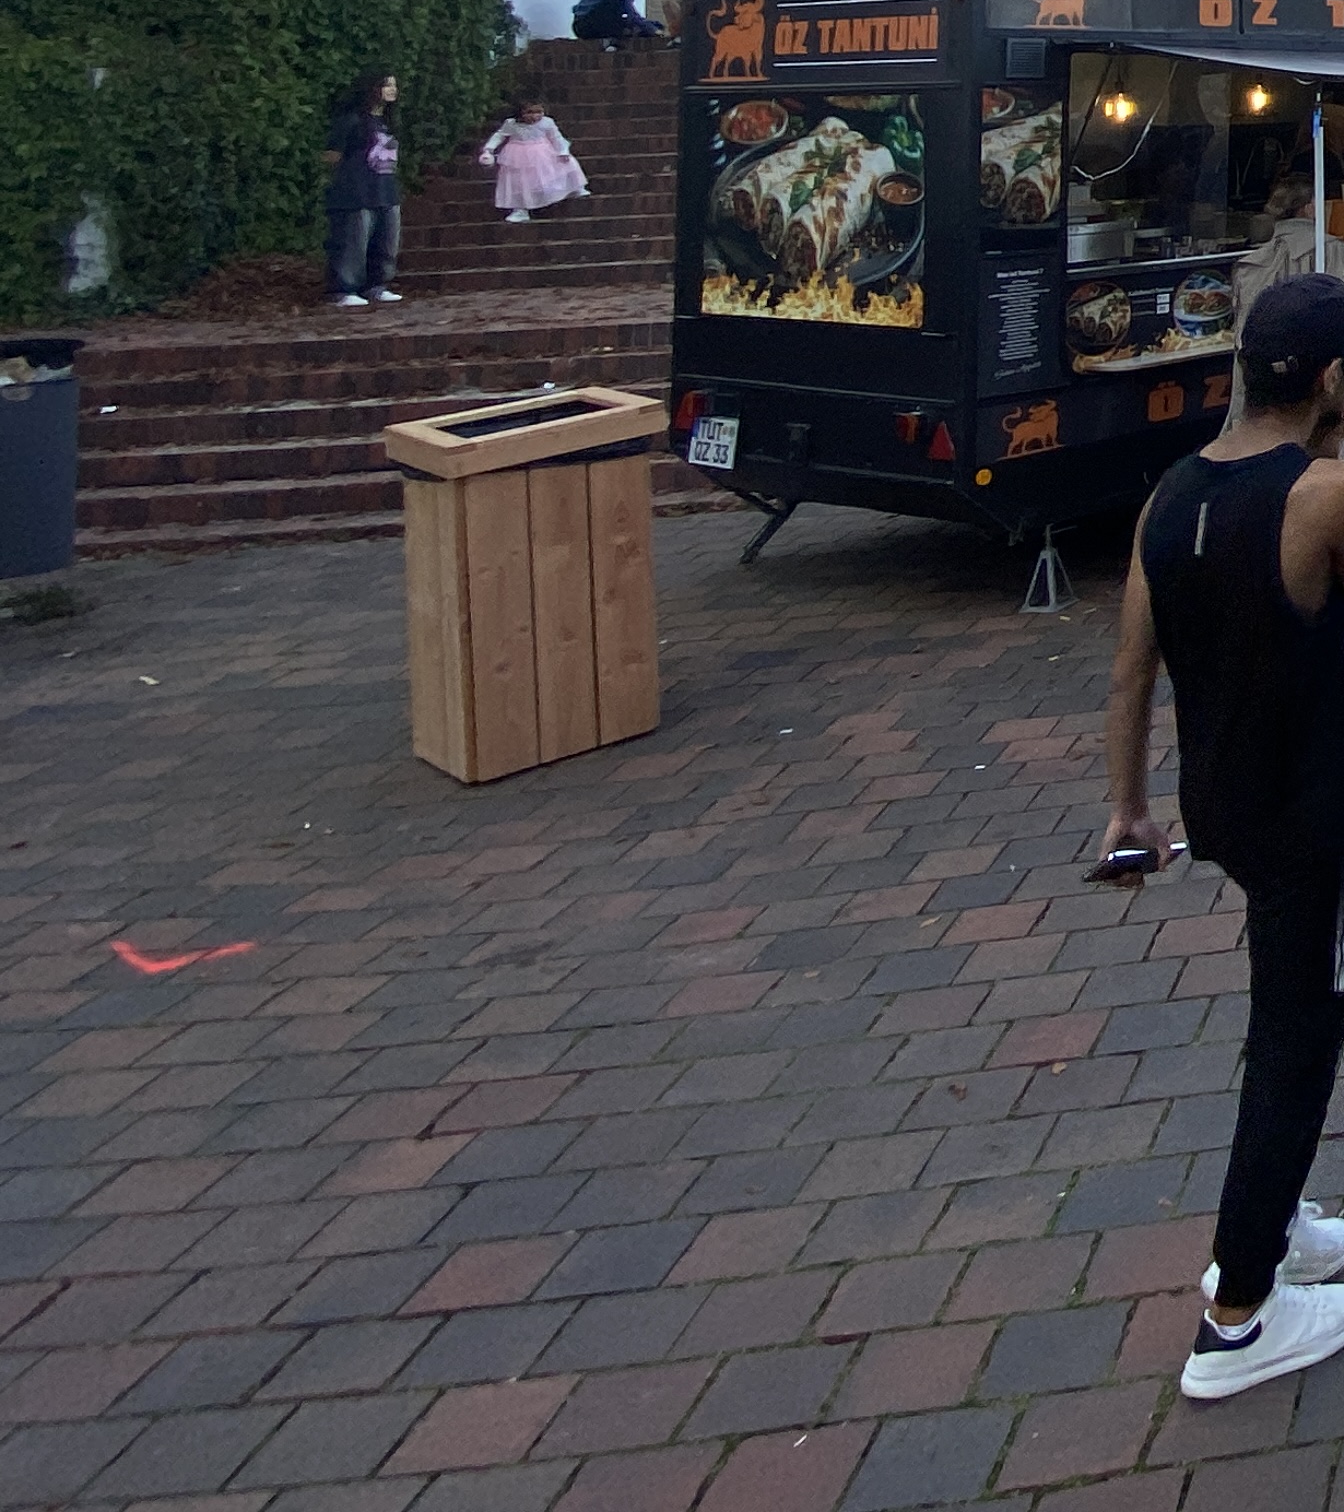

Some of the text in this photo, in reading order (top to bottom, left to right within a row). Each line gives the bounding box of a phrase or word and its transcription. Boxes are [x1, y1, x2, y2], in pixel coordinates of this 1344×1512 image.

[774, 14, 809, 56] ÖZ
[701, 419, 724, 441] TUT
[713, 443, 729, 464] 33
